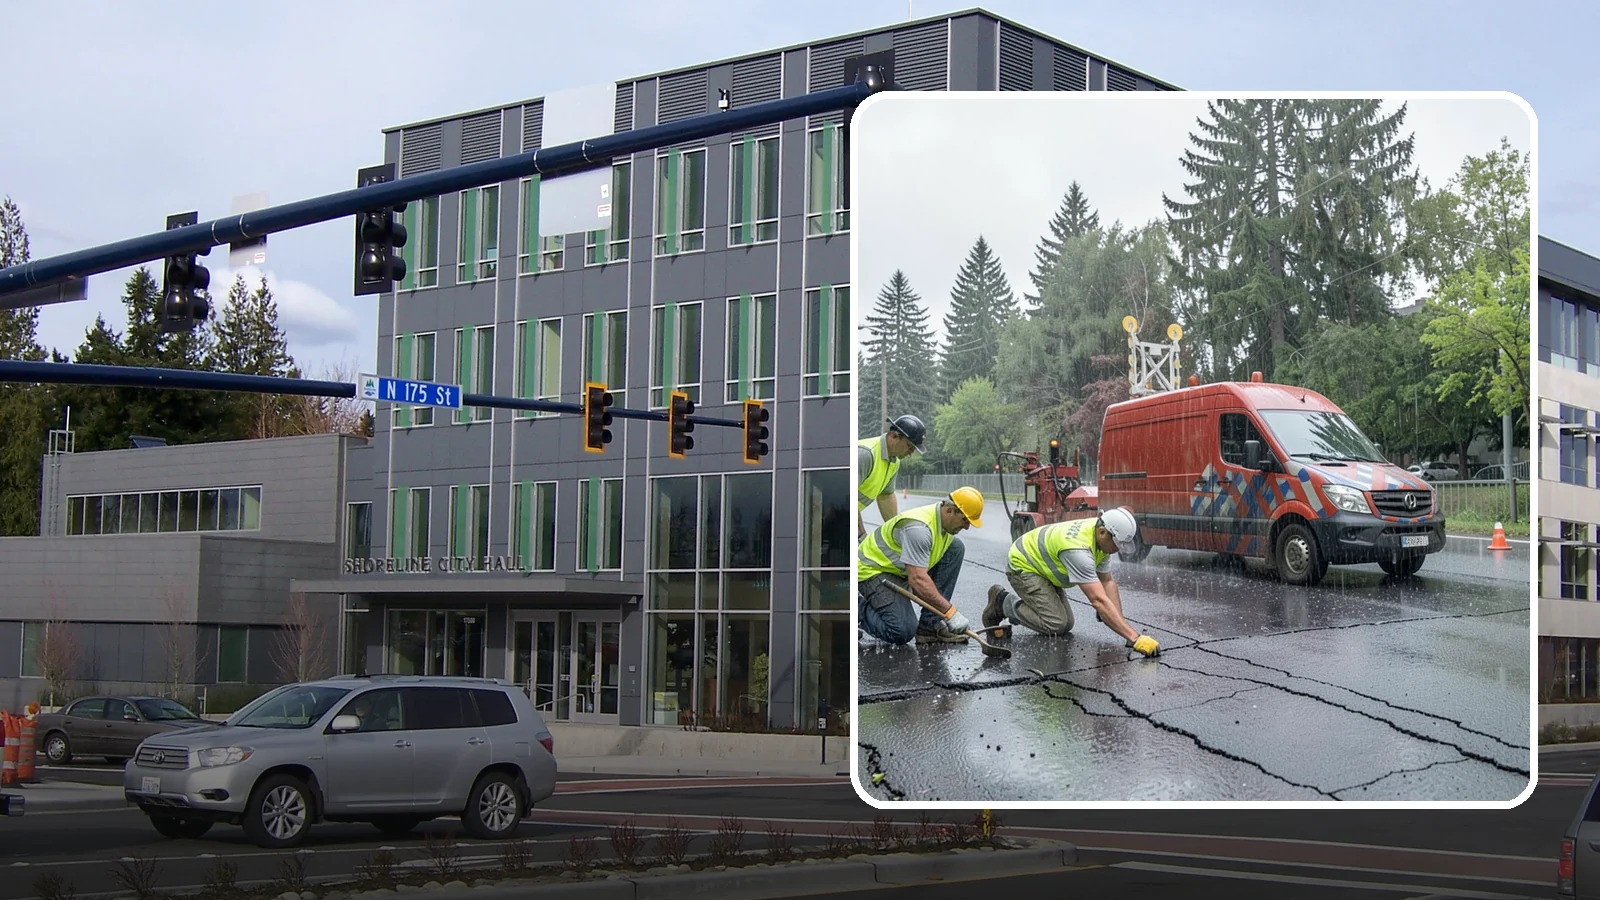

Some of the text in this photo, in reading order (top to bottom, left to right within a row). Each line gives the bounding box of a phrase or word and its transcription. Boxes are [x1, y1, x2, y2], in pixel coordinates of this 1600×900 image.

[387, 380, 451, 406] N 175 St
[344, 555, 526, 574] SHORELINE CITY HALL
